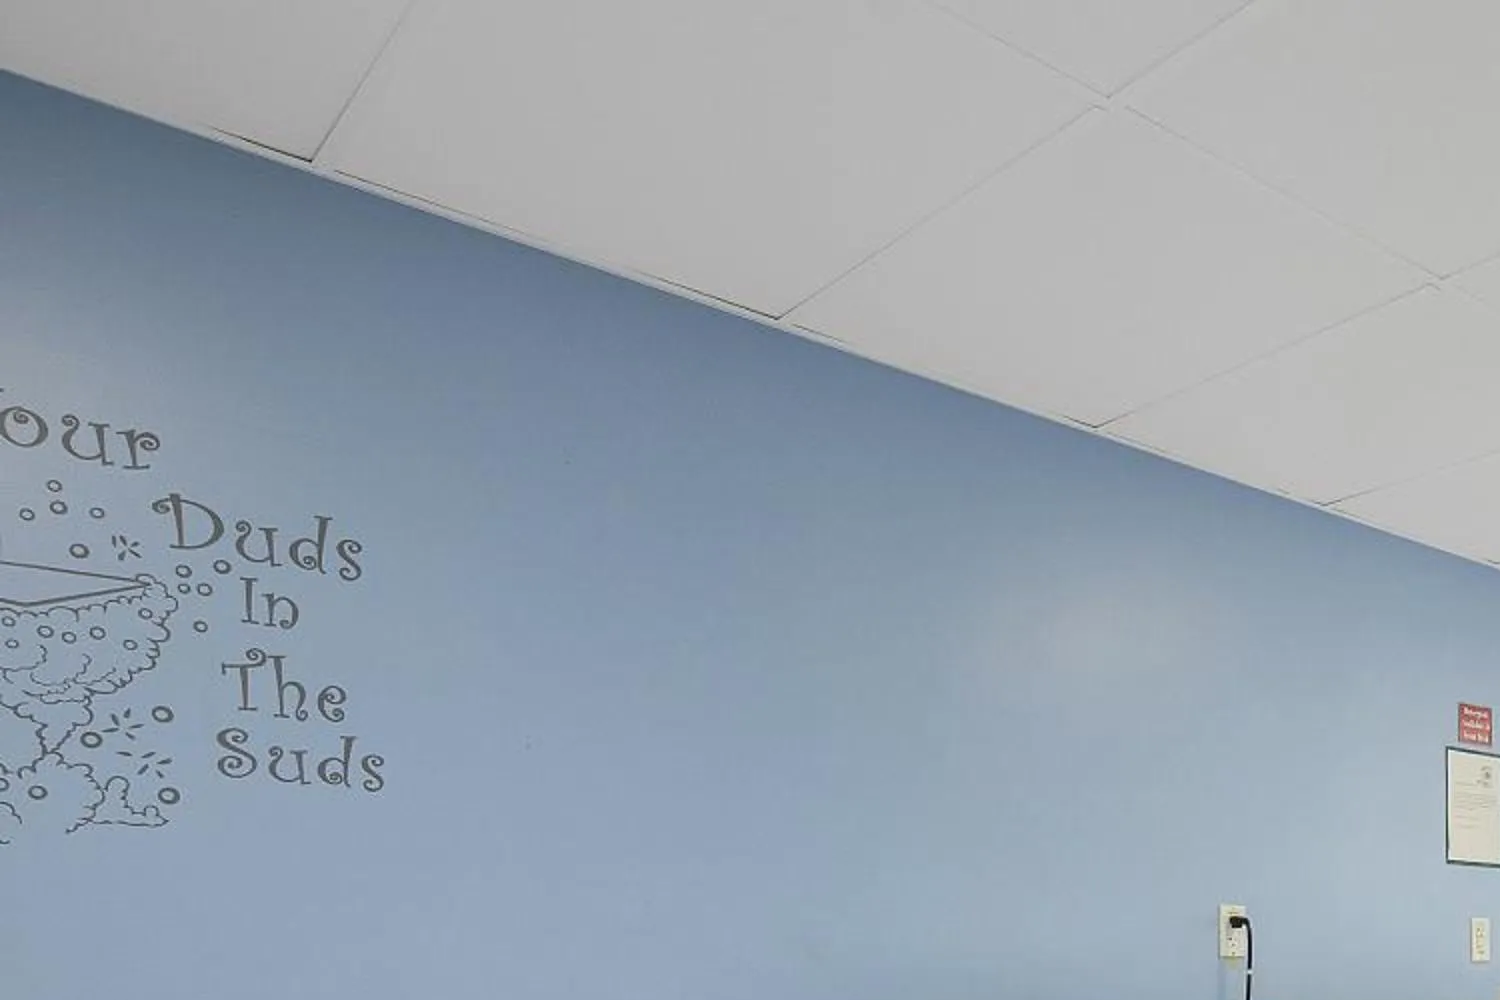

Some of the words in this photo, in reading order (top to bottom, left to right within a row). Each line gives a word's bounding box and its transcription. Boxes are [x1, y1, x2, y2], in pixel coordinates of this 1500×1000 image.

[0, 388, 160, 470] our
[151, 493, 363, 581] Duds
[239, 576, 300, 630] In
[221, 647, 347, 722] The
[216, 727, 385, 793] Suds
